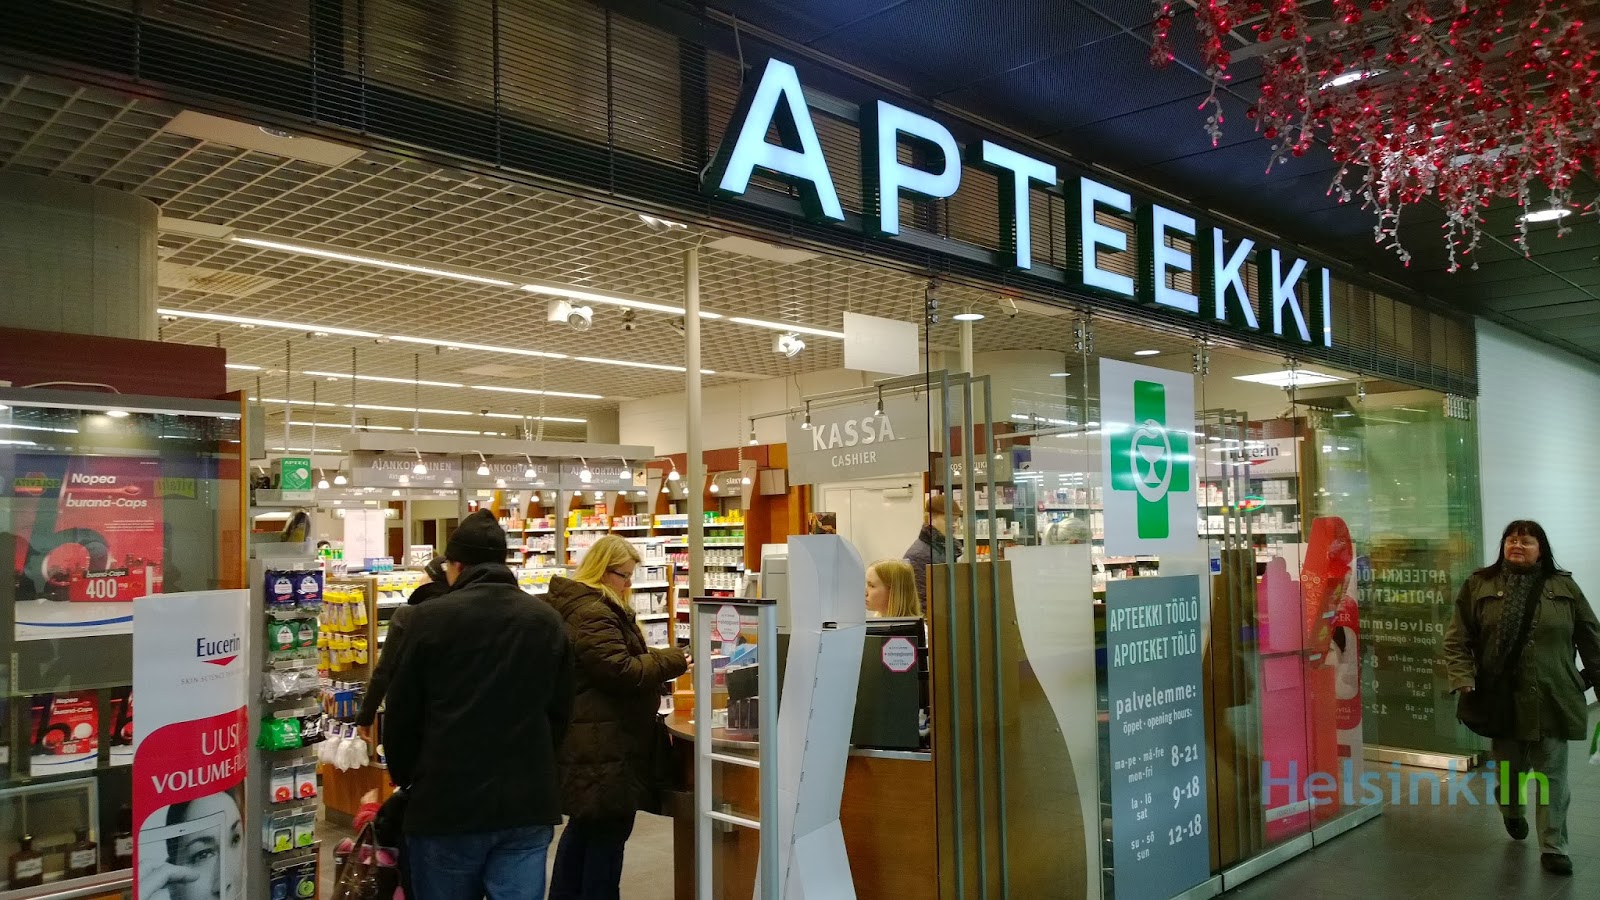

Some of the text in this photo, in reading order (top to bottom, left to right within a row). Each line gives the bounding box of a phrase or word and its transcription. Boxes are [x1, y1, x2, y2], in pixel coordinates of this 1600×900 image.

[719, 57, 1332, 348] APTEEKKI
[812, 415, 895, 451] KASSA
[371, 458, 452, 471] AJANKOHAINEN
[831, 451, 877, 467] CASHIER
[71, 473, 117, 486] Nopea
[66, 493, 148, 509] burana-Caps
[86, 579, 117, 598] 400
[1110, 596, 1198, 632] APTEEKKI TÖÖLÖ
[196, 633, 240, 657] Eucerin
[1114, 629, 1197, 667] APOTEKET TÖLÖ
[1116, 684, 1196, 720] palvelemme:
[1123, 719, 1143, 736] öppet
[1147, 712, 1173, 729] opening
[202, 723, 239, 755] UUSI
[1114, 744, 1198, 770] ma-pe må-fre 8-21
[1128, 765, 1153, 783] mon-fri
[1145, 793, 1152, 805] lö
[1172, 776, 1200, 809] 9-18
[1136, 808, 1148, 820] sat
[1131, 813, 1202, 850] su sö 12-18
[1137, 848, 1150, 861] sun
